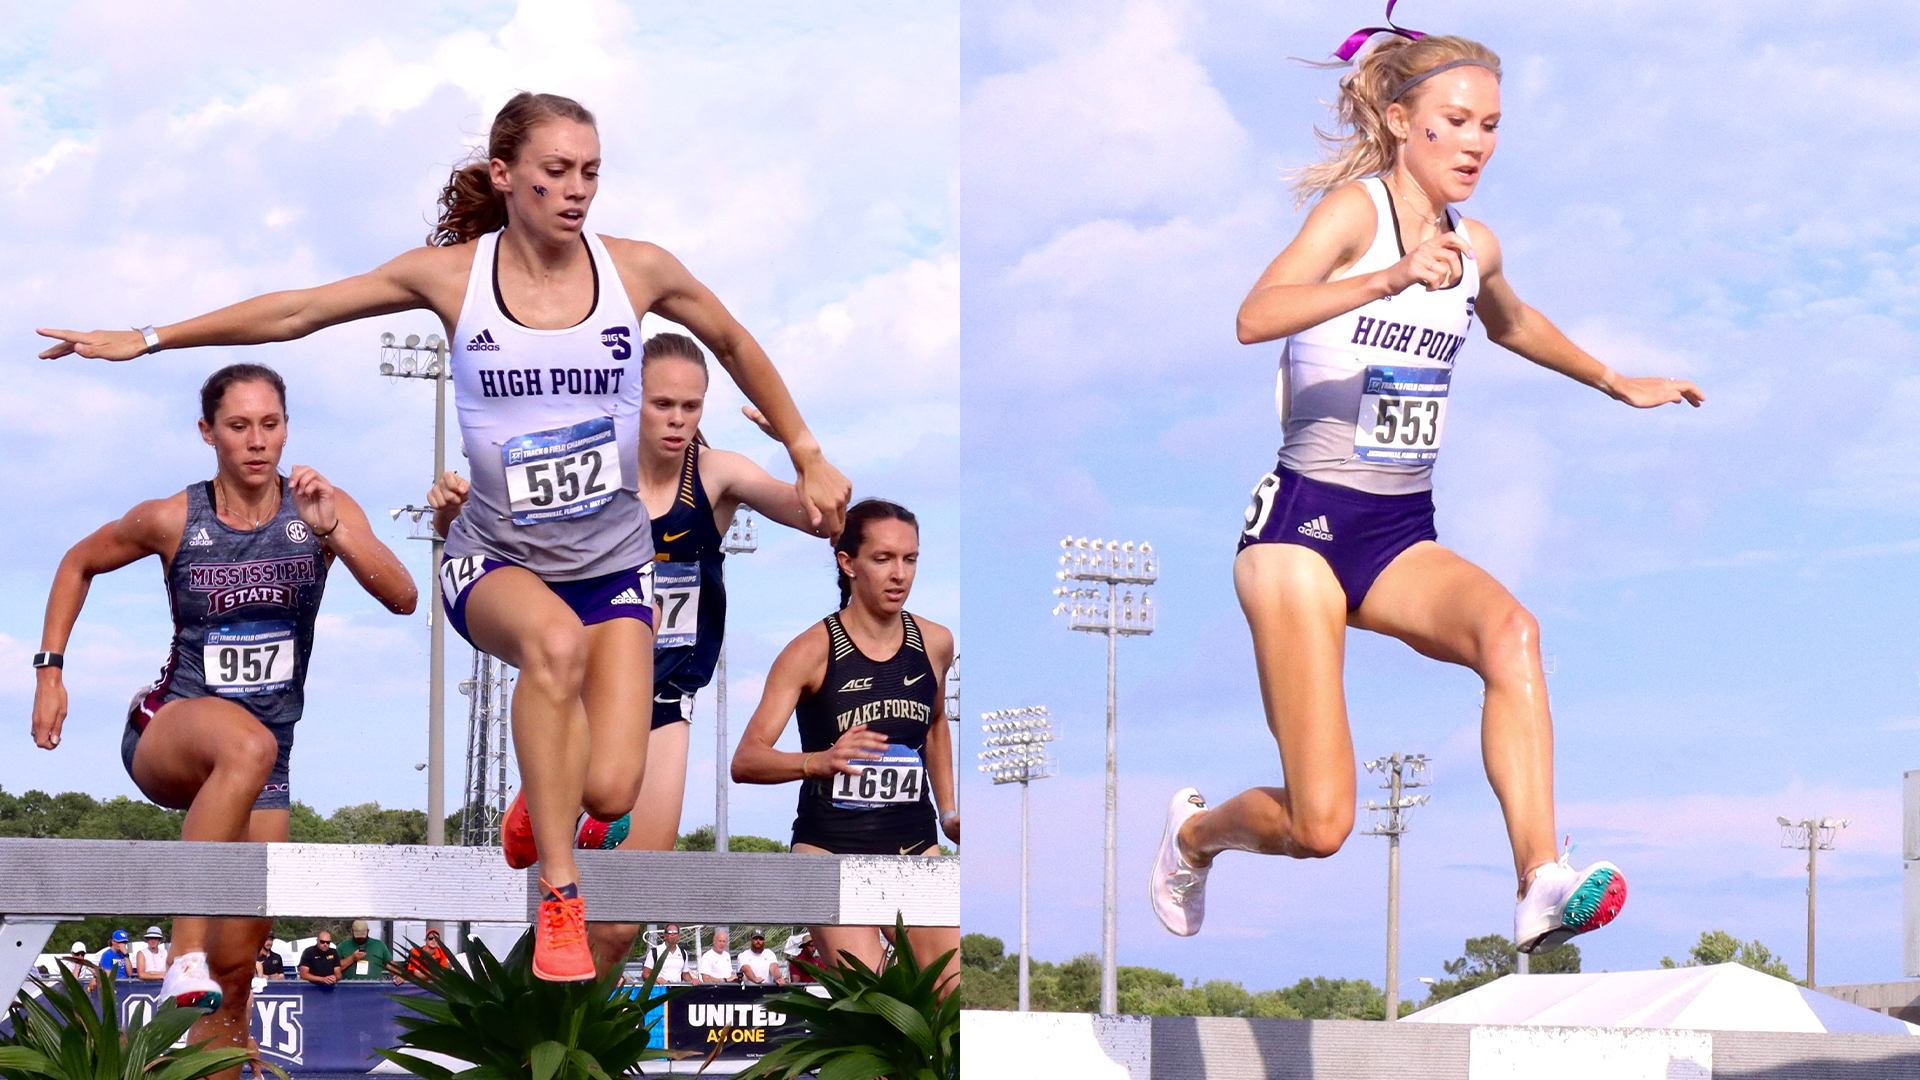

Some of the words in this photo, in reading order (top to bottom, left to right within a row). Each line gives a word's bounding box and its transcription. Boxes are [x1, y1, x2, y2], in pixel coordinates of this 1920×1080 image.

[466, 343, 500, 351] adidas
[1351, 315, 1417, 353] HIGH
[1414, 327, 1466, 364] POIN
[479, 369, 543, 398] HIGH
[552, 368, 624, 395] POINT
[1375, 398, 1439, 446] 553
[523, 448, 543, 458] TRACK
[549, 444, 565, 454] FIELD
[566, 430, 612, 450] CHAMPIONSHIPS
[525, 450, 606, 506] 552
[189, 539, 214, 547] adidas
[288, 522, 308, 540] SEC
[1297, 525, 1334, 542] adidas
[190, 559, 315, 587] MISSISSIPPI
[445, 556, 478, 596] 14
[224, 586, 284, 609] STATE
[611, 597, 642, 605] adidas
[220, 633, 237, 641] TRACK
[219, 644, 280, 683] 957
[839, 676, 874, 691] ACC
[836, 700, 881, 733] WAKE
[883, 699, 931, 725] FOREST
[838, 767, 919, 800] 1694
[731, 1029, 765, 1043] ONE
